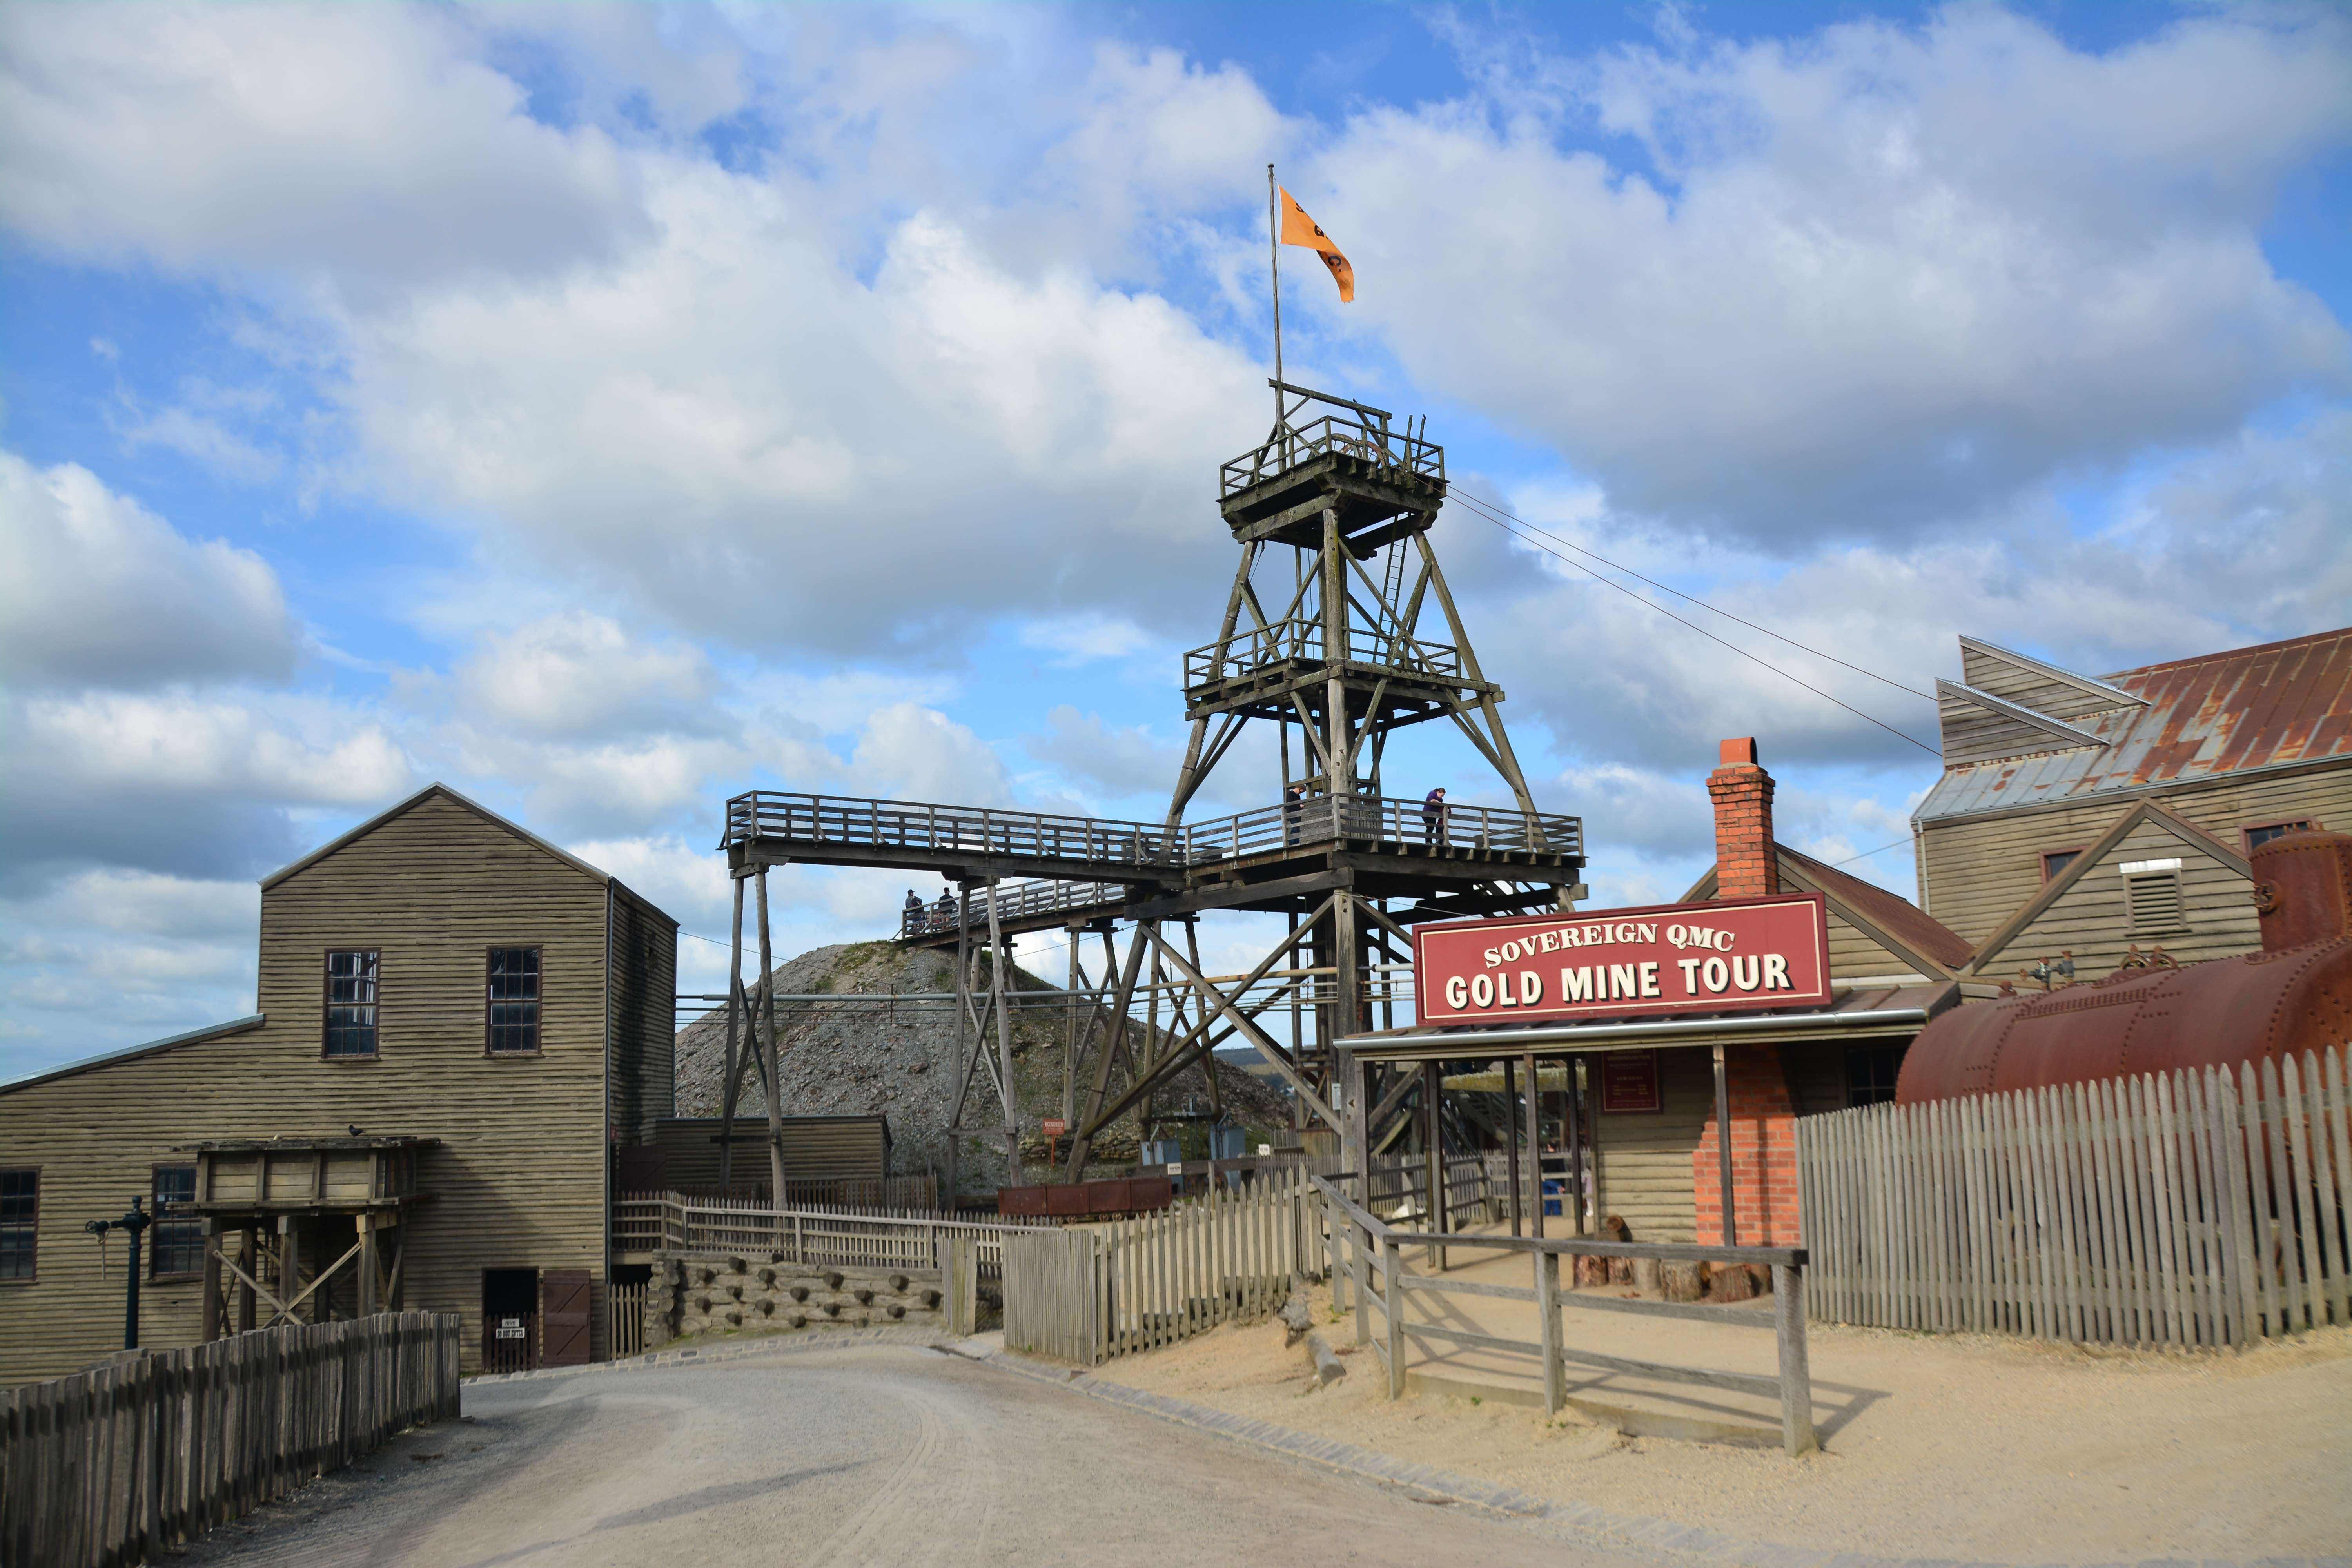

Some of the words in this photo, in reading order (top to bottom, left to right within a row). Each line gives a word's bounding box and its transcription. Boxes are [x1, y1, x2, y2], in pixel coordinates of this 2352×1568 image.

[1483, 923, 1659, 969] SOVEREIGN
[1666, 924, 1735, 952] QMC
[1445, 970, 1544, 1011] GOLD
[1561, 962, 1662, 1004] MINE
[1677, 953, 1795, 996] TOUR
